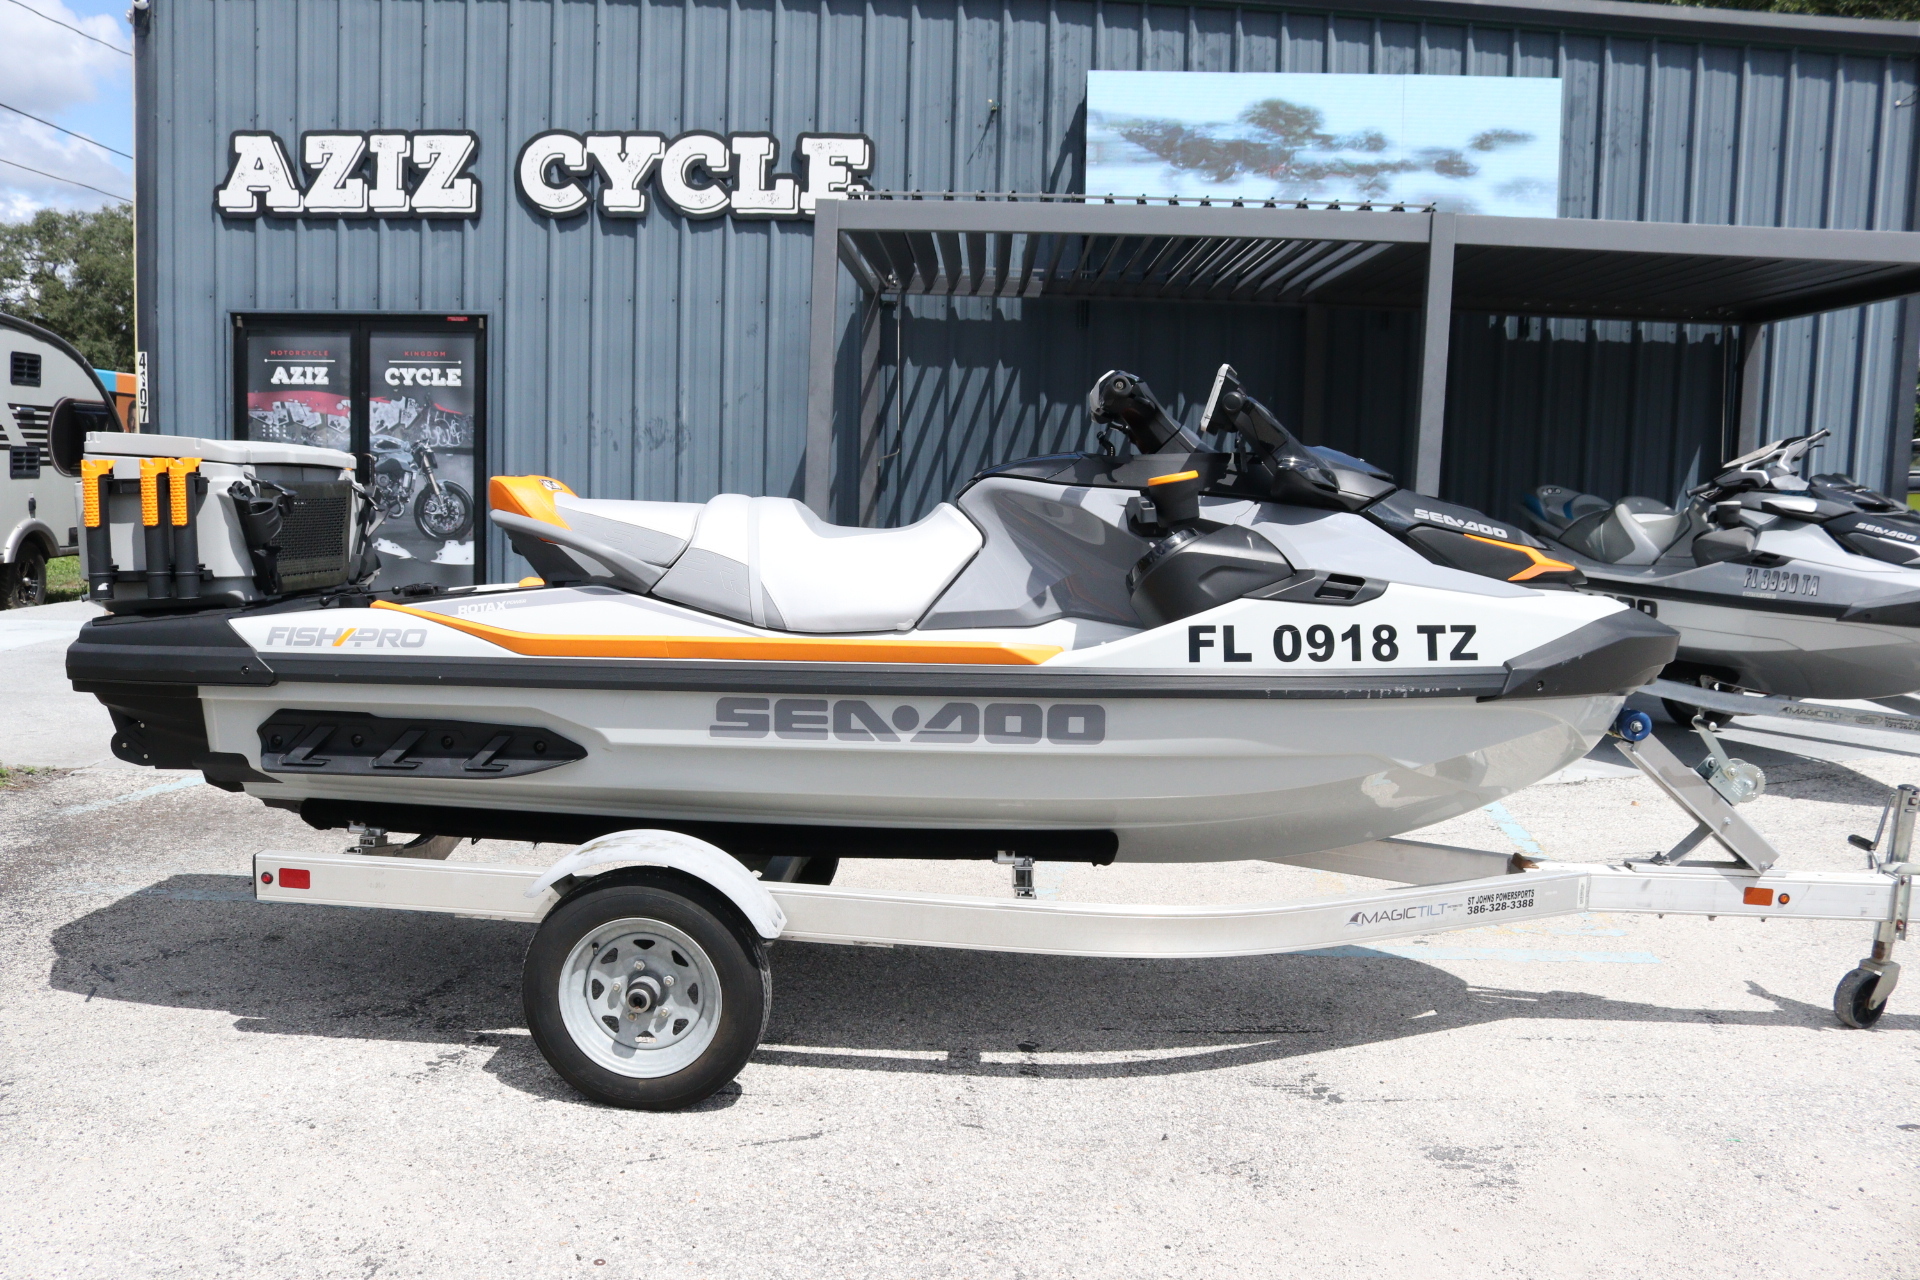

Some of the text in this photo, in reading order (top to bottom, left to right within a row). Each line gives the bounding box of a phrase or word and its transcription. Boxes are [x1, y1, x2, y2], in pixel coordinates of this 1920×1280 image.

[217, 131, 872, 216] AZIZ CYCLE
[270, 366, 330, 385] AZIZ
[384, 367, 462, 386] CYCLE
[1743, 567, 1759, 588] FL
[1801, 574, 1820, 596] TA
[1188, 624, 1480, 662] FL 0918 TZ
[1467, 889, 1535, 906] ST JOHNS POWERSPORTS
[1467, 899, 1534, 915] 386-328-3388
[1361, 903, 1448, 924] MAGICTILT
